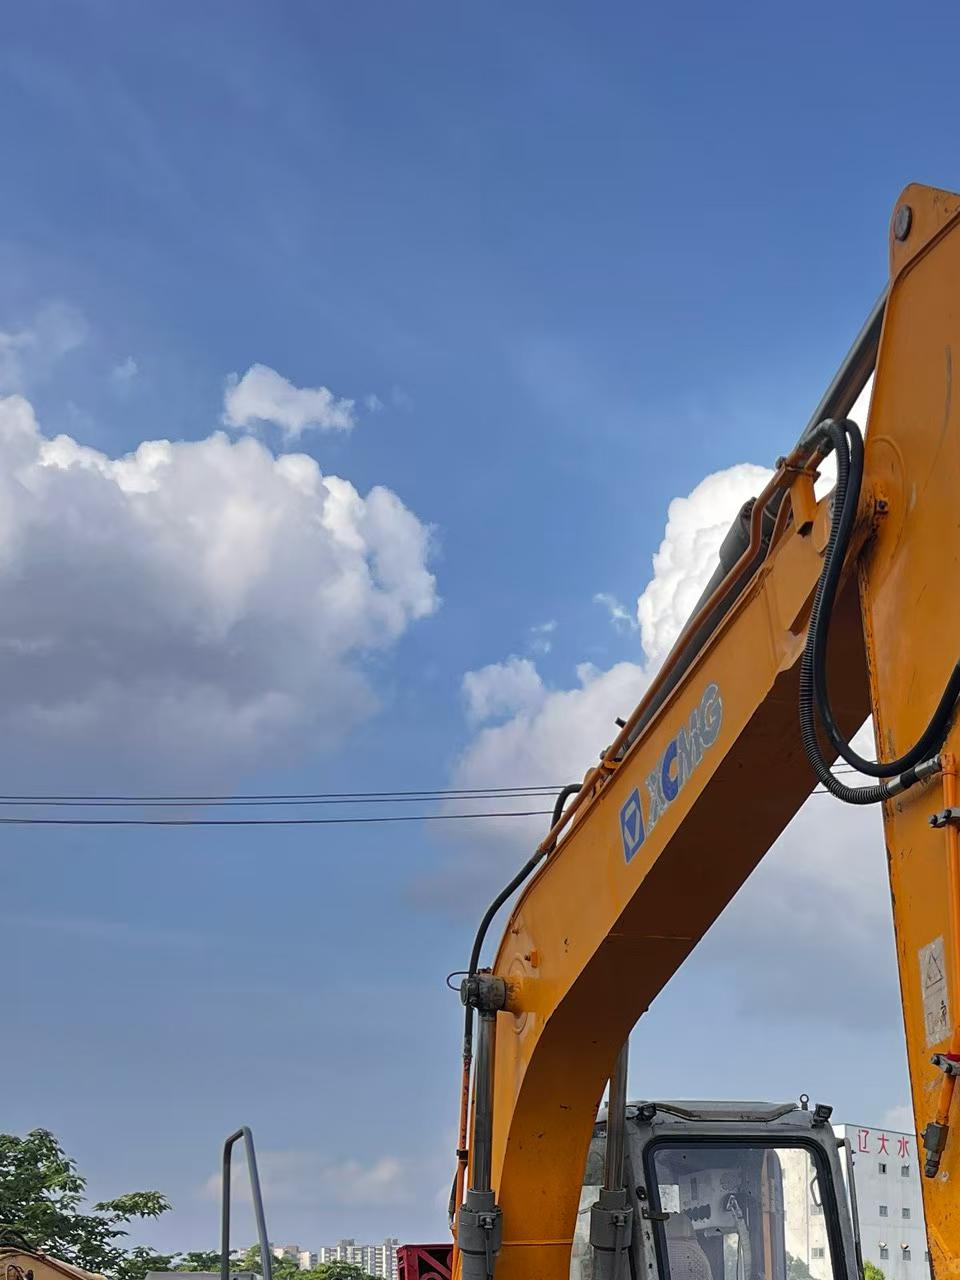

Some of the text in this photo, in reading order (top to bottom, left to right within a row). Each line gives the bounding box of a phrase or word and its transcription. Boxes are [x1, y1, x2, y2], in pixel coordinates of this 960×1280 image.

[645, 684, 723, 835] XCMG
[857, 1129, 910, 1159] 辽大水
